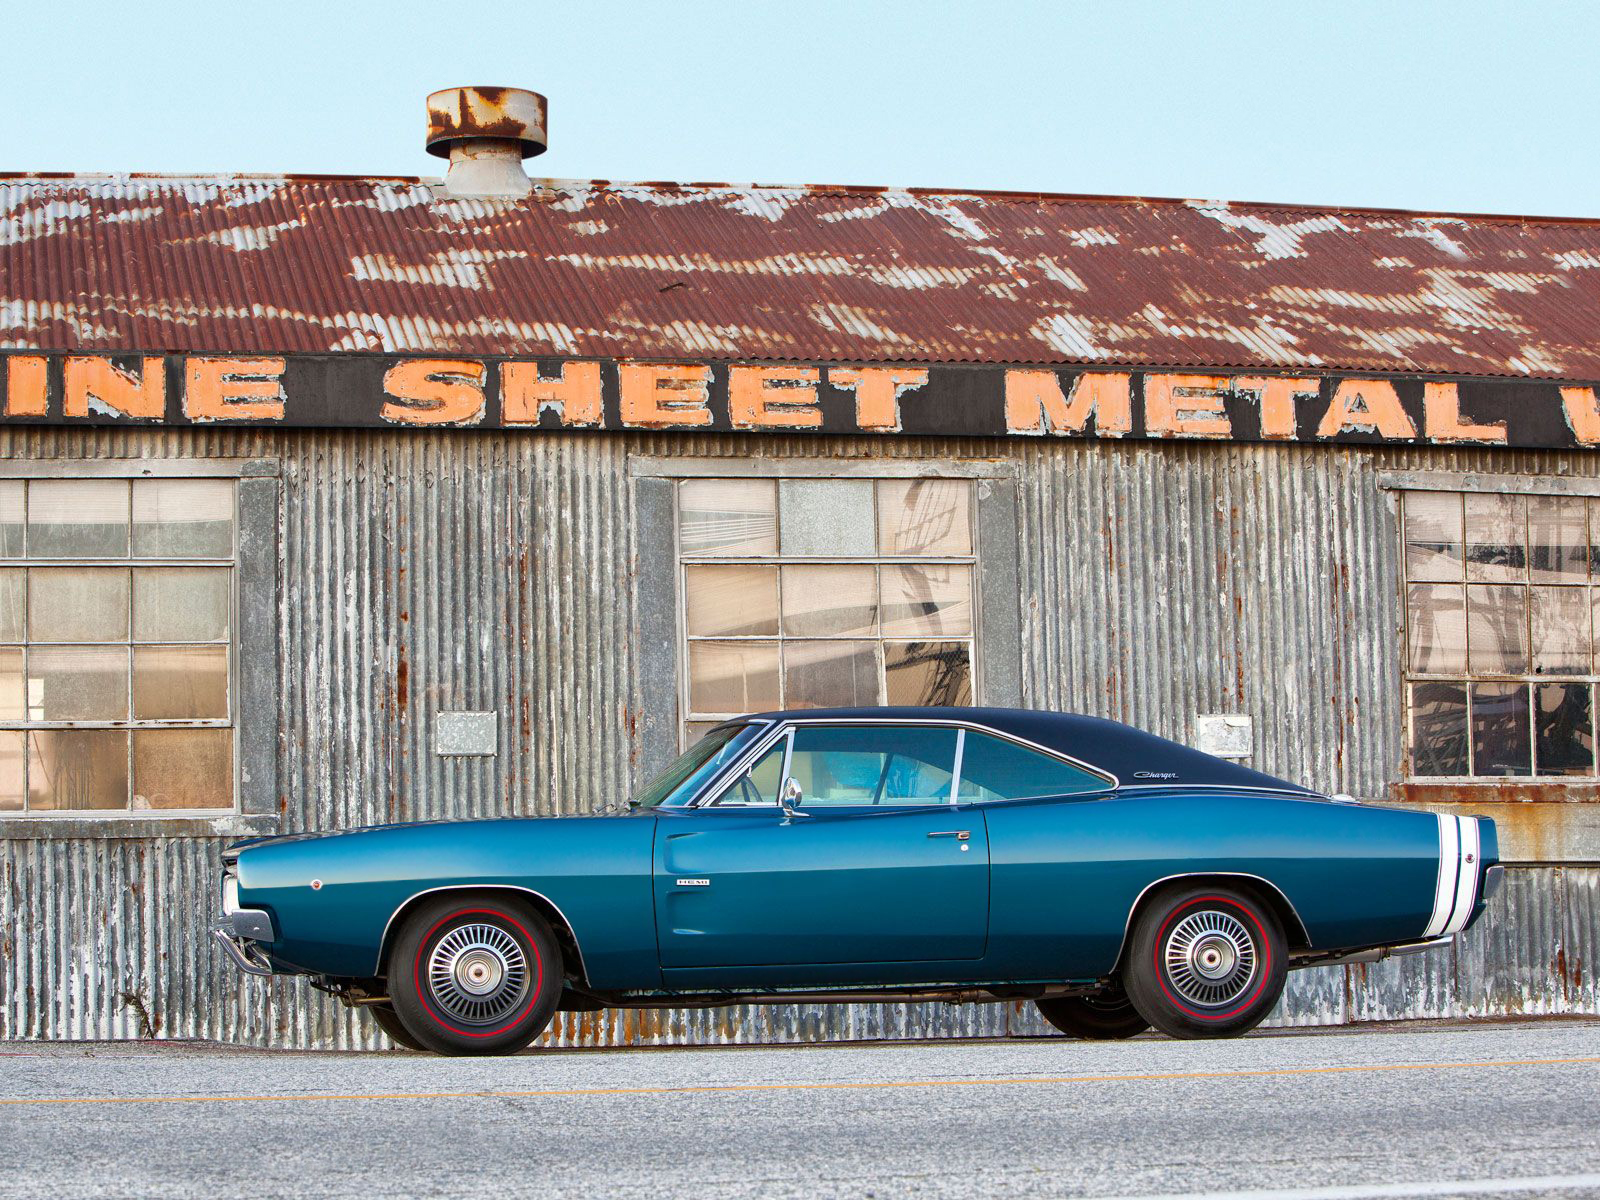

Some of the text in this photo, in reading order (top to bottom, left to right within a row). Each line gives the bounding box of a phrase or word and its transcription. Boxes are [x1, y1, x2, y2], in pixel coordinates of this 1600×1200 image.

[3, 354, 287, 423] INE
[379, 358, 930, 432] SHEET
[1004, 367, 1508, 446] METAL
[1133, 771, 1179, 780] Charger
